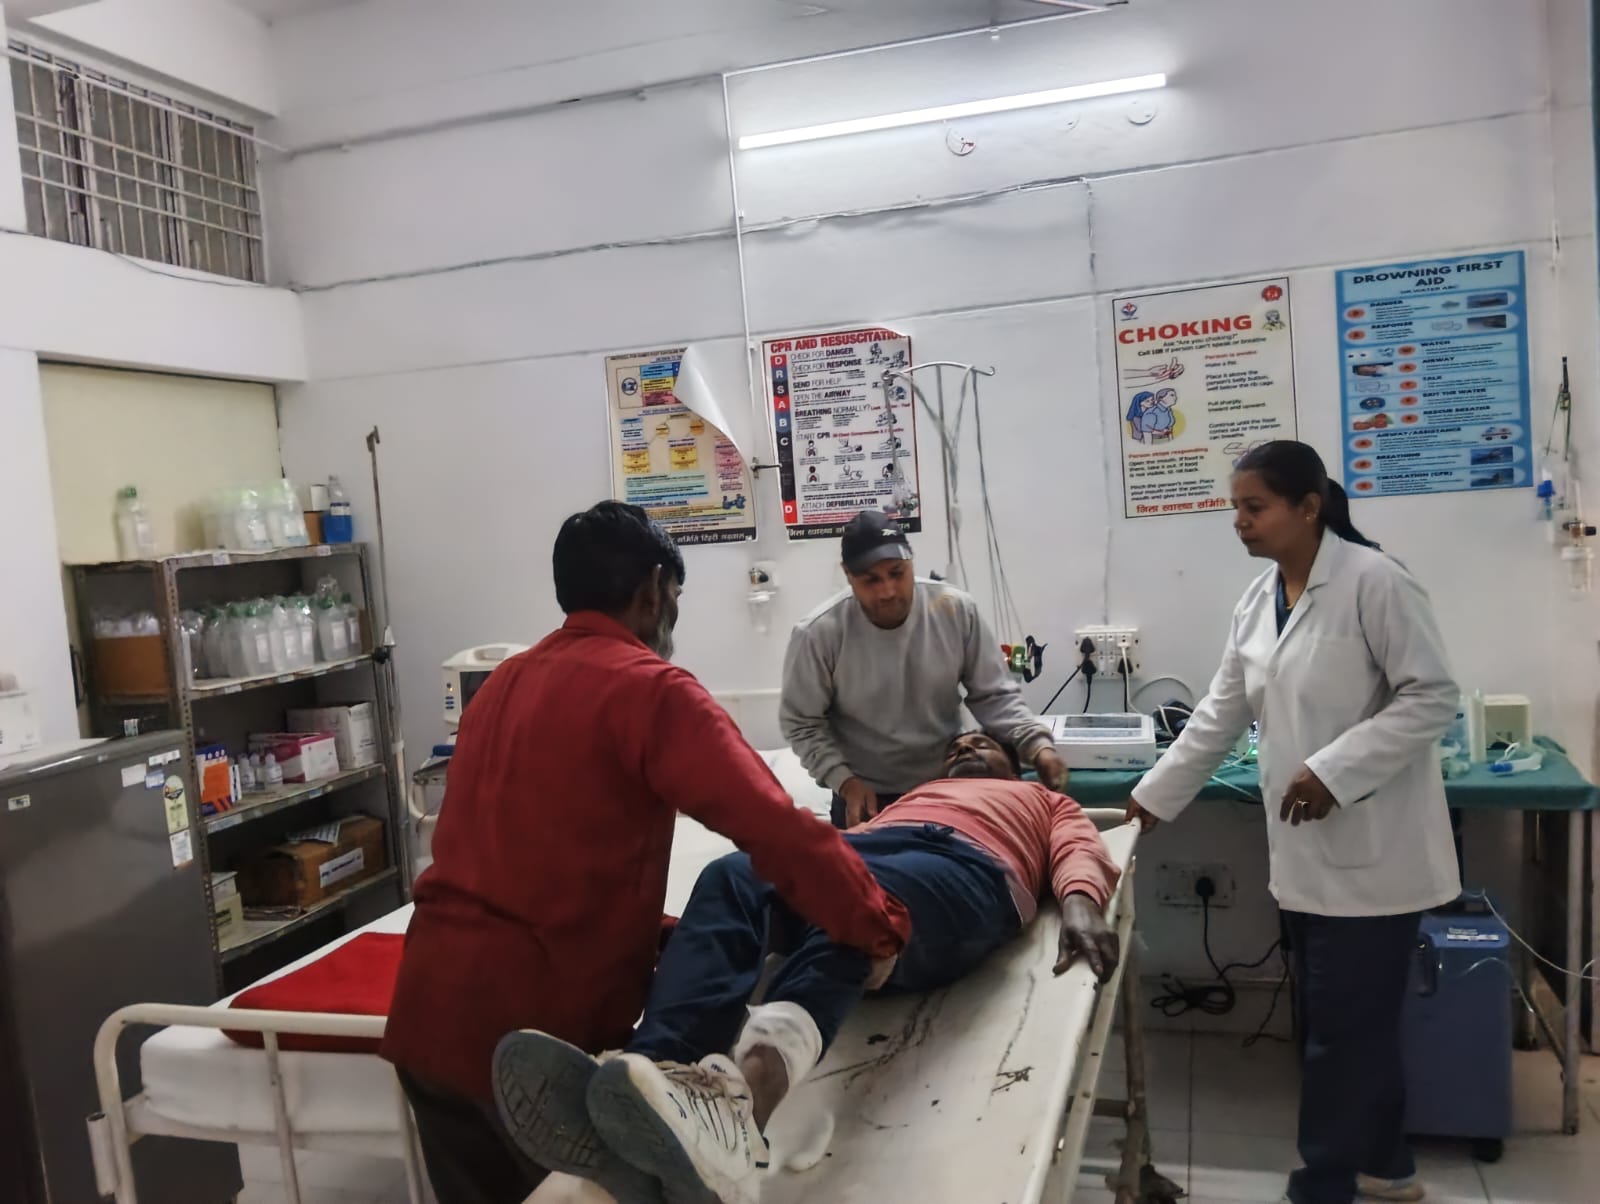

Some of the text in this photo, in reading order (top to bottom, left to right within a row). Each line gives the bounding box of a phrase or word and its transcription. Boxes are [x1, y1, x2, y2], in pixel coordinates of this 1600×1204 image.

[1353, 261, 1503, 284] DROWNING FIRST
[1416, 277, 1444, 286] AID
[1119, 315, 1252, 344] CHOKING
[770, 331, 906, 353] CPR AND RESUSCITATIO
[791, 347, 854, 360] CHECK FOR DANGER
[792, 364, 812, 373] CHECK
[827, 359, 862, 369] RESPONSE
[776, 370, 783, 378] R
[793, 378, 841, 388] SEND FOR HELP
[776, 385, 784, 394] S
[793, 393, 810, 401] OPEN
[824, 390, 851, 398] AIRWAY
[778, 401, 786, 409] A
[795, 408, 832, 417] BREATHING
[779, 418, 787, 426] B
[796, 432, 814, 440] START
[780, 438, 789, 446] C
[801, 501, 825, 509] ATTACH
[826, 498, 878, 508] DEFIBRILLATOR
[1197, 497, 1226, 508] समिति
[785, 505, 792, 513] D
